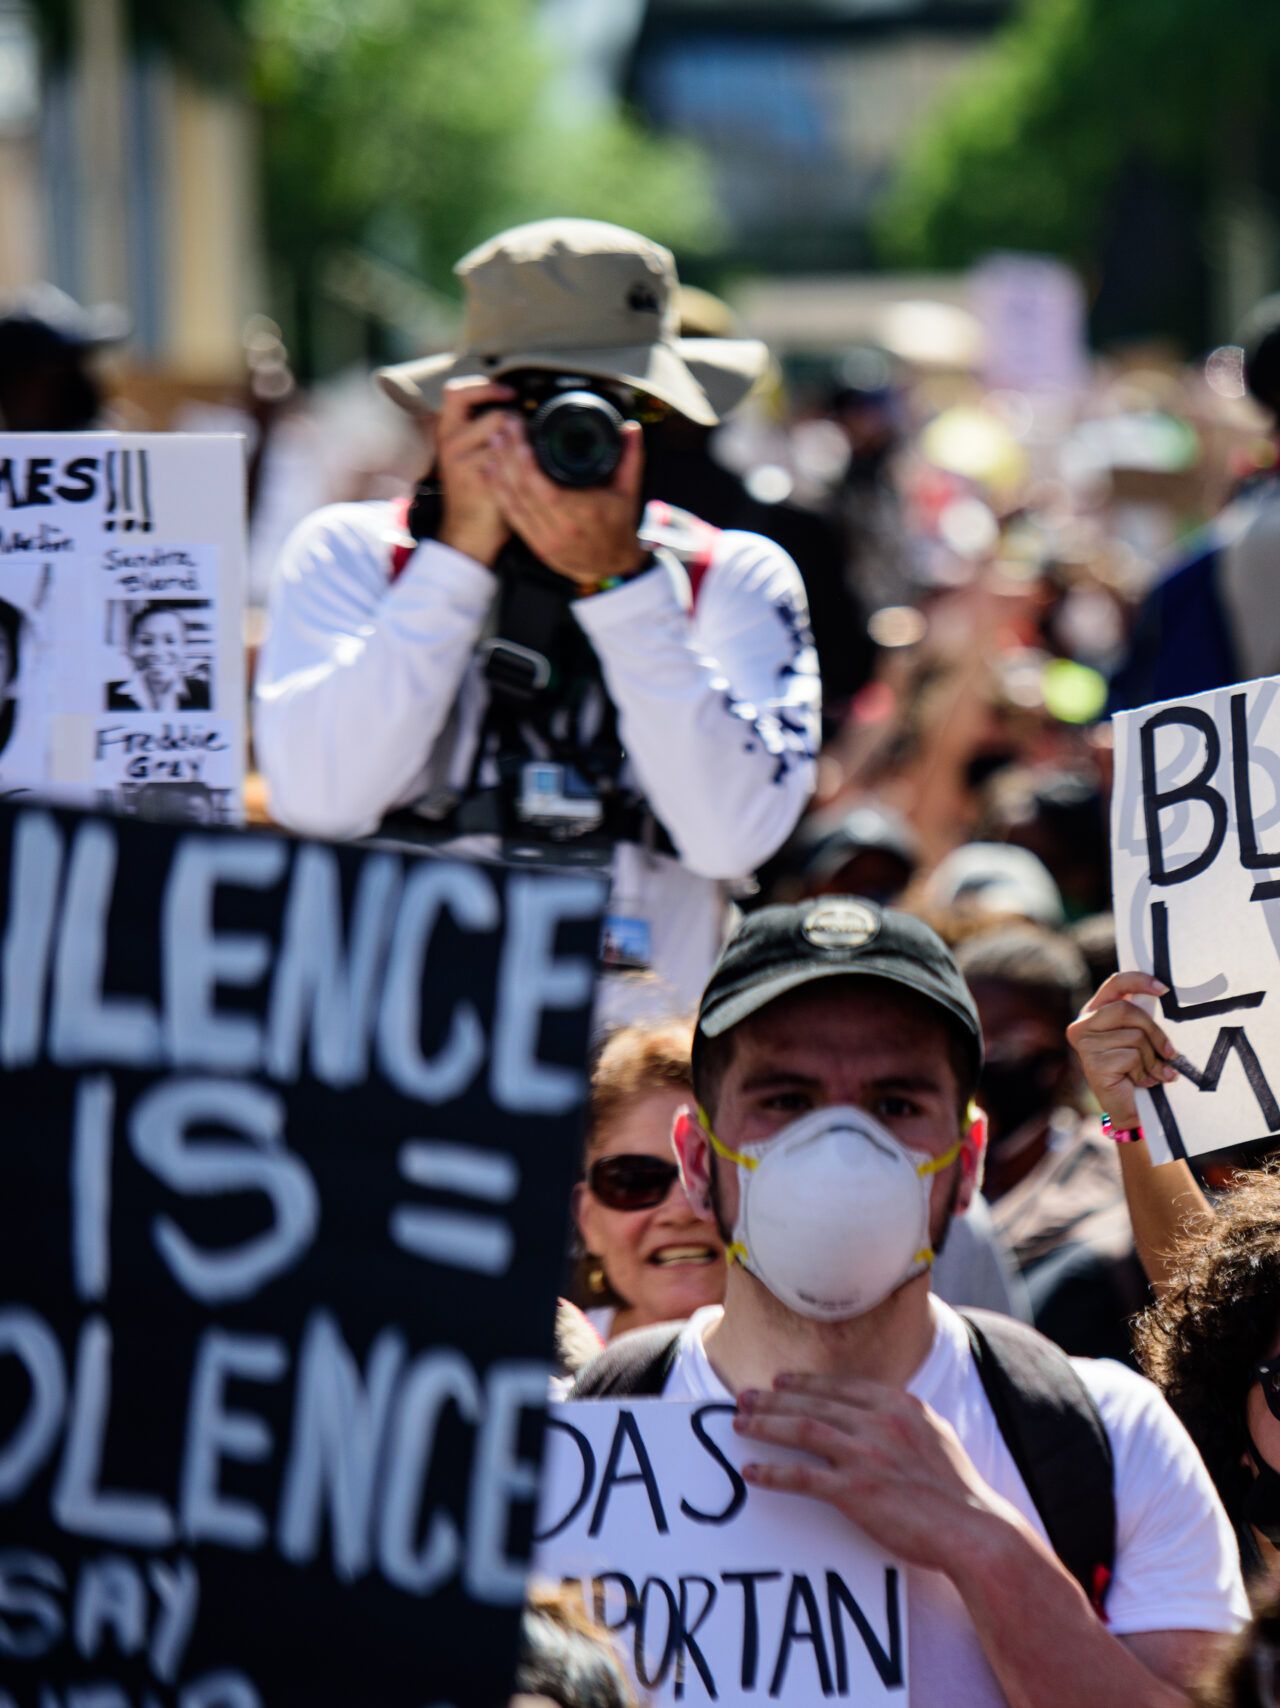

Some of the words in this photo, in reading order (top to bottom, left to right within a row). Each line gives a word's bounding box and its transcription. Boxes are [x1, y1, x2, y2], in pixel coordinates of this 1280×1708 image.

[95, 724, 229, 760] Freddie
[72, 1072, 318, 1300] IS
[0, 1548, 200, 1686] SAY
[563, 1567, 904, 1702] PORTAN
